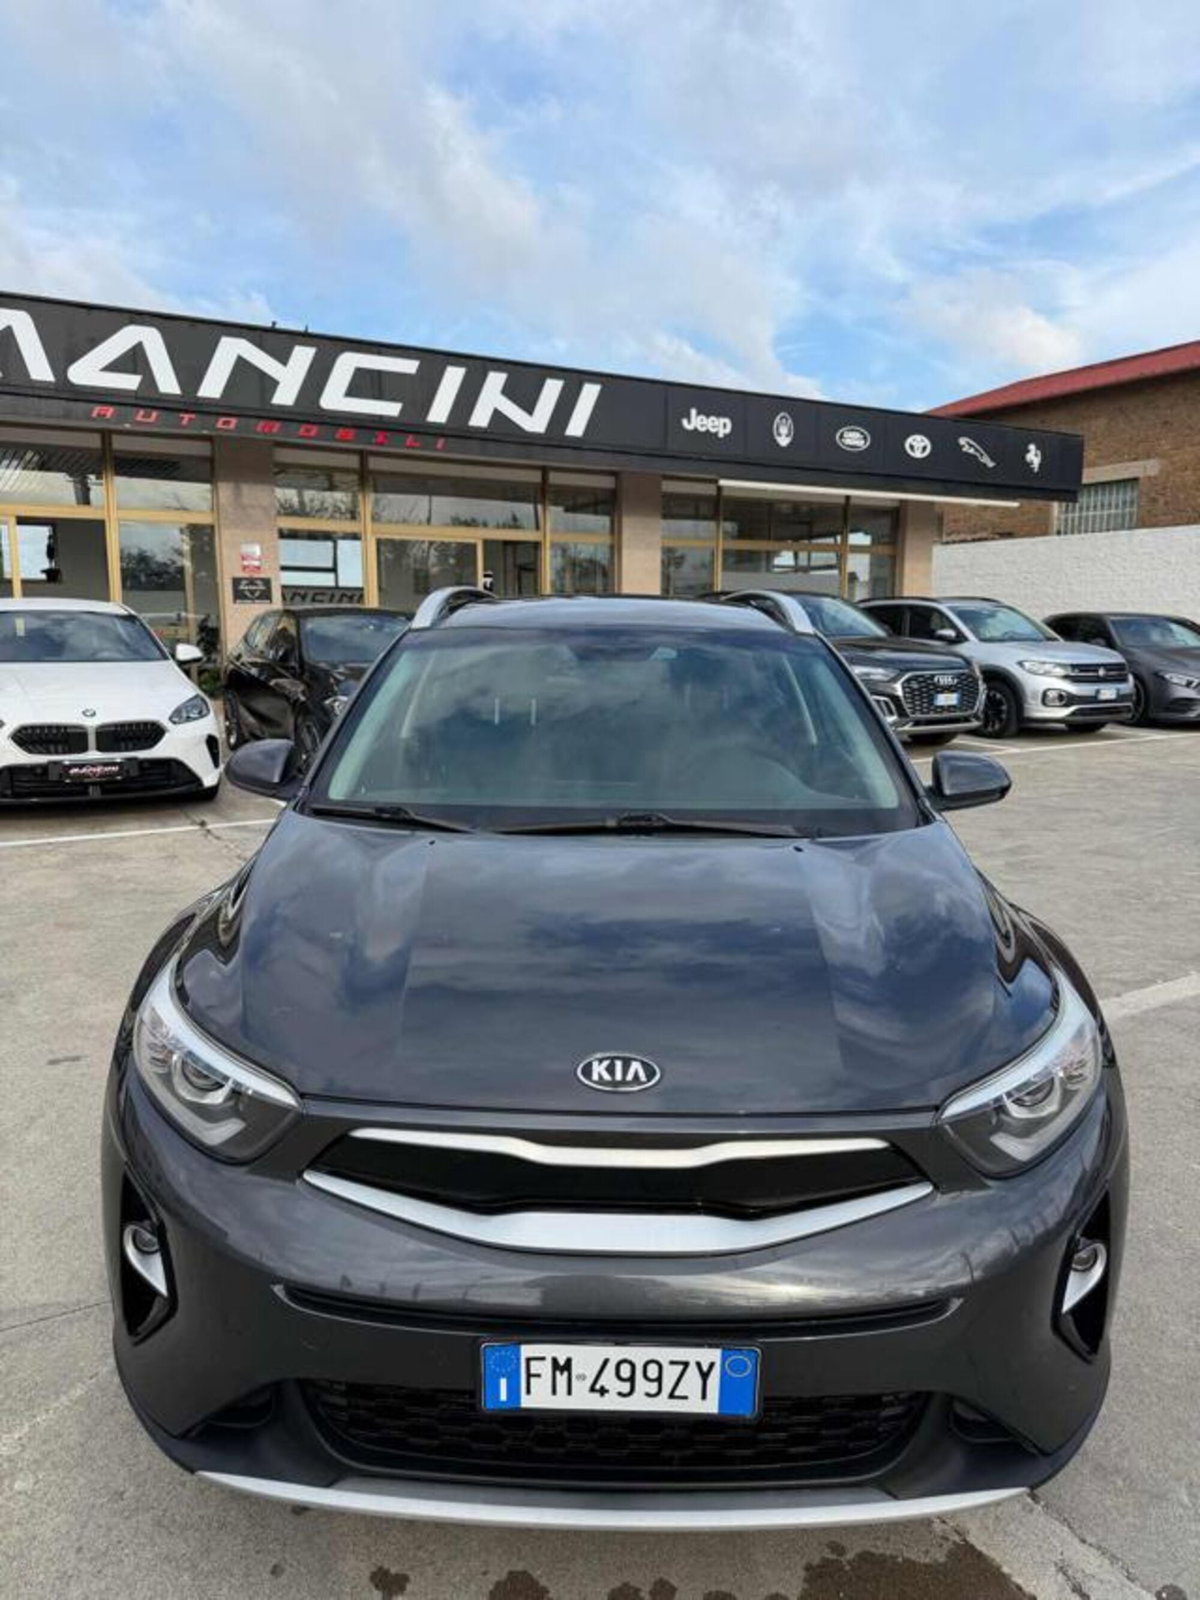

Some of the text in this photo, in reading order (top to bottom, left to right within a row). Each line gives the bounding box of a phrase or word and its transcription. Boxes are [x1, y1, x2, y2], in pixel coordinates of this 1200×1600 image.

[90, 406, 446, 449] AUTOMOBILI
[682, 408, 732, 438] Jeep
[591, 1059, 648, 1082] KIA
